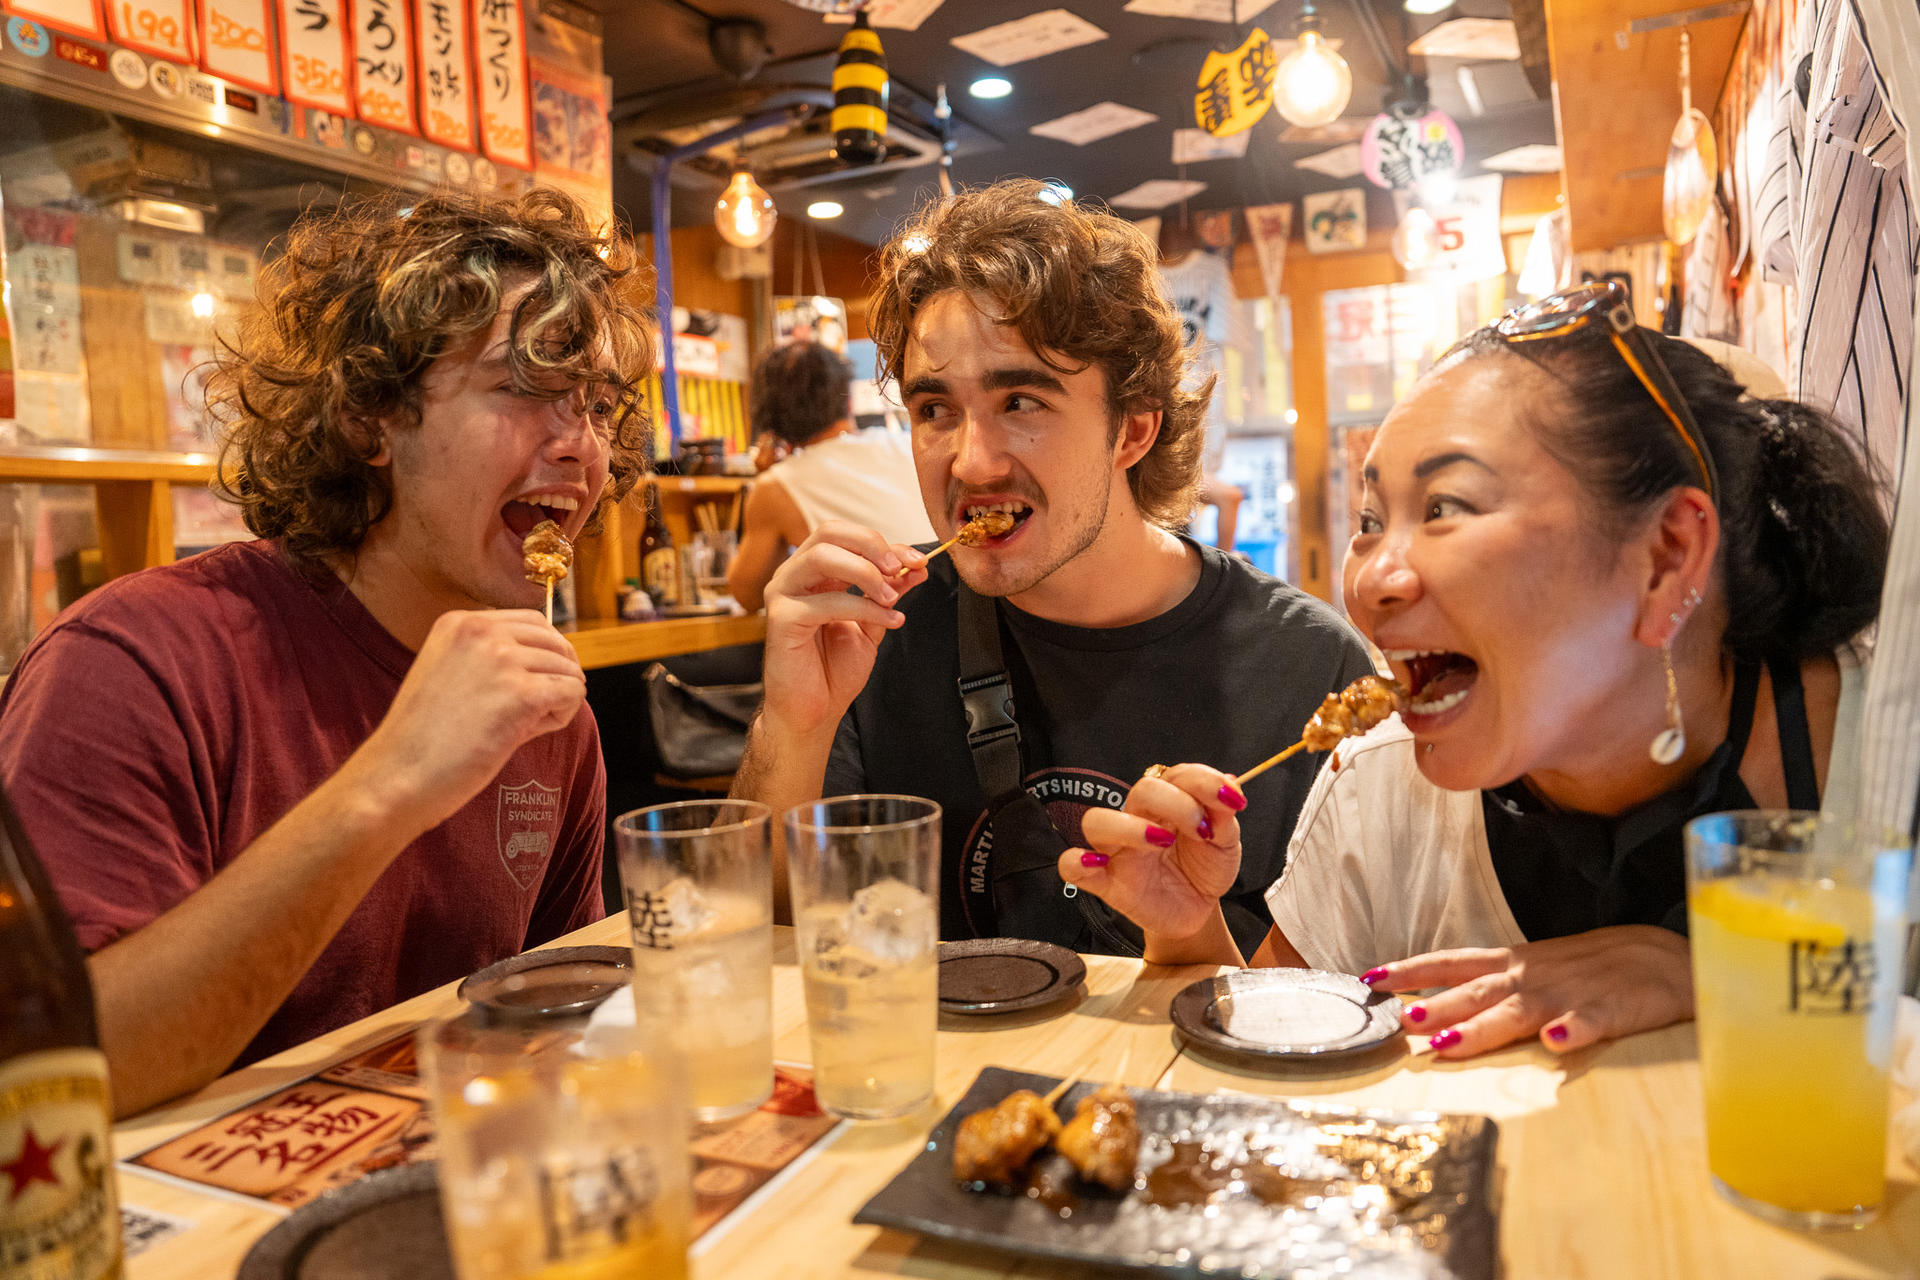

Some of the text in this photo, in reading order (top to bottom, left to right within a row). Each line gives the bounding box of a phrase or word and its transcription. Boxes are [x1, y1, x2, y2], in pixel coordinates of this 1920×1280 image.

[123, 2, 178, 47] 199
[211, 8, 266, 50] 500
[292, 53, 344, 95] 350
[505, 791, 556, 806] FRANKLIN
[508, 810, 553, 821] SYNDICATE
[1025, 778, 1127, 812] RTSHISTO
[970, 821, 993, 893] MARTI
